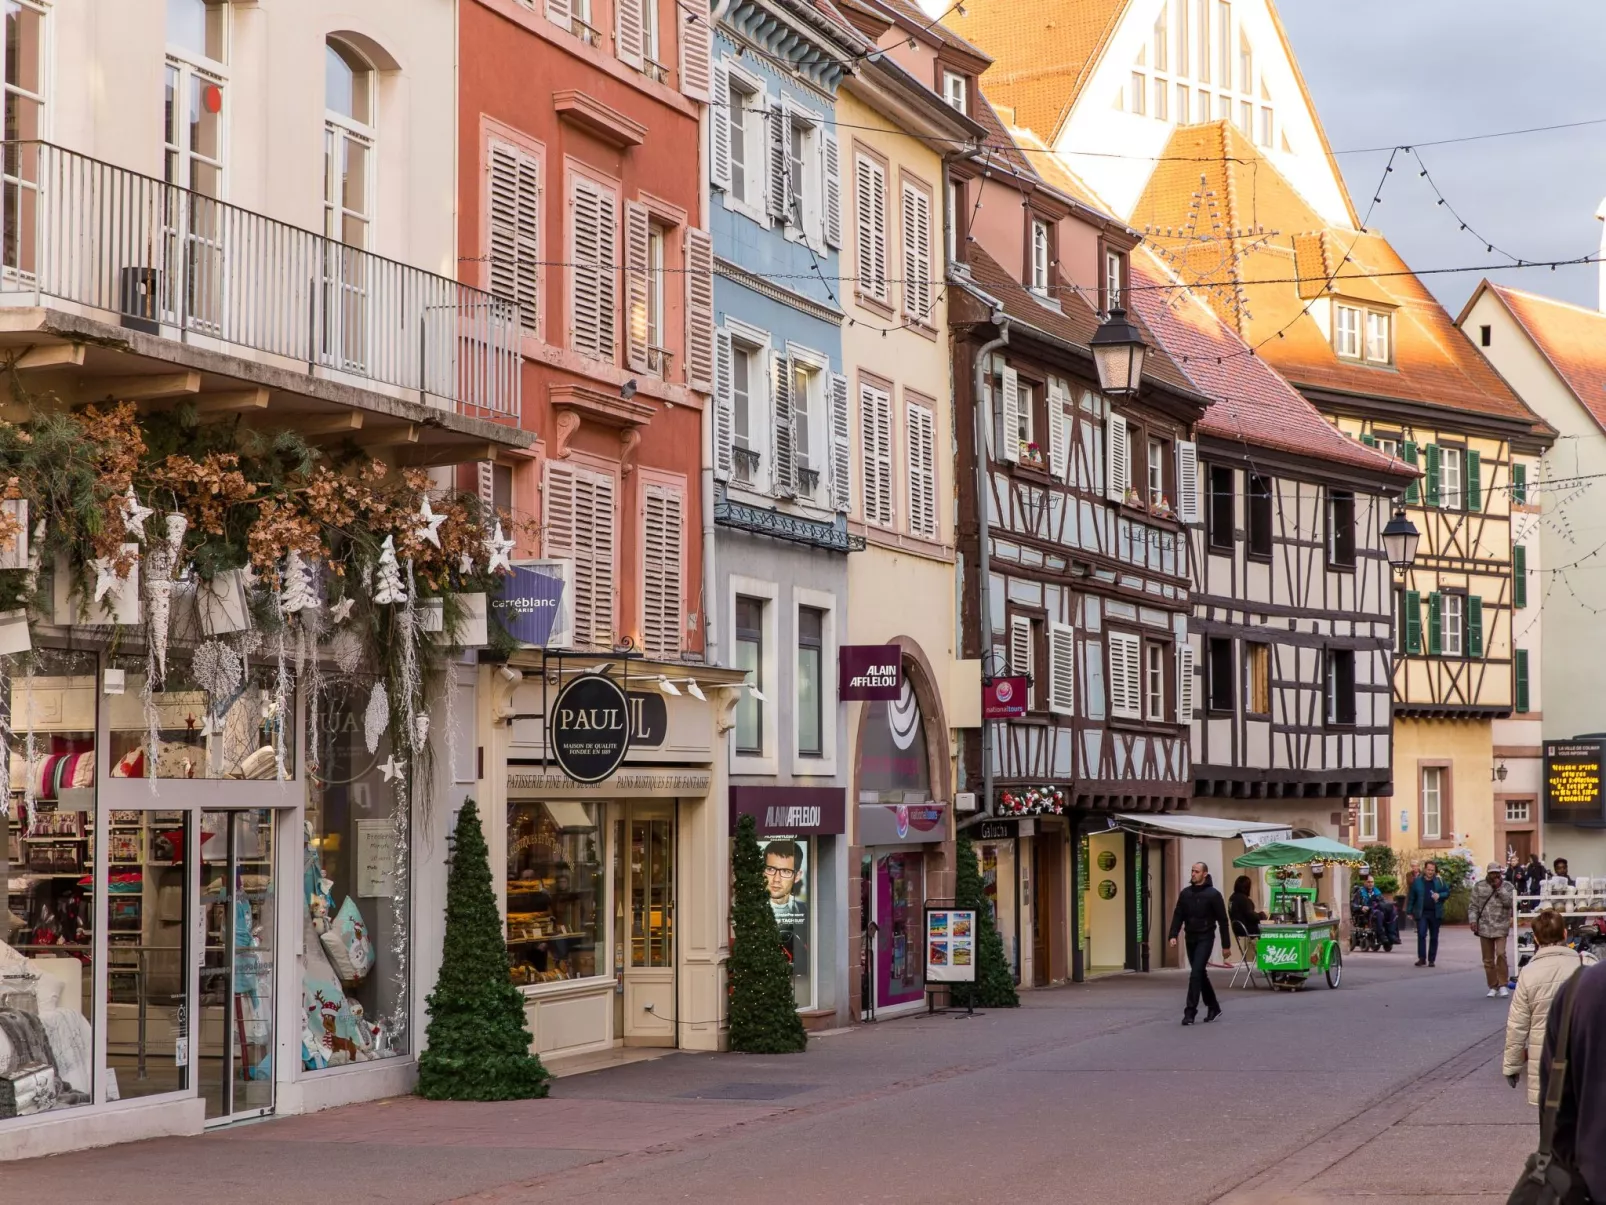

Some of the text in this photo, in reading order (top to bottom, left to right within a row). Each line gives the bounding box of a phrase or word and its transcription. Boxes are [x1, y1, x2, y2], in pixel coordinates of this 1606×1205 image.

[866, 665, 897, 676] ALAIN
[849, 676, 897, 687] AFFLELOU
[560, 709, 624, 730] PAUL
[545, 774, 562, 789] FINE
[616, 775, 634, 789] PAINS
[665, 776, 674, 789] ET
[673, 776, 683, 789] DE
[1275, 946, 1298, 964] Yolo
